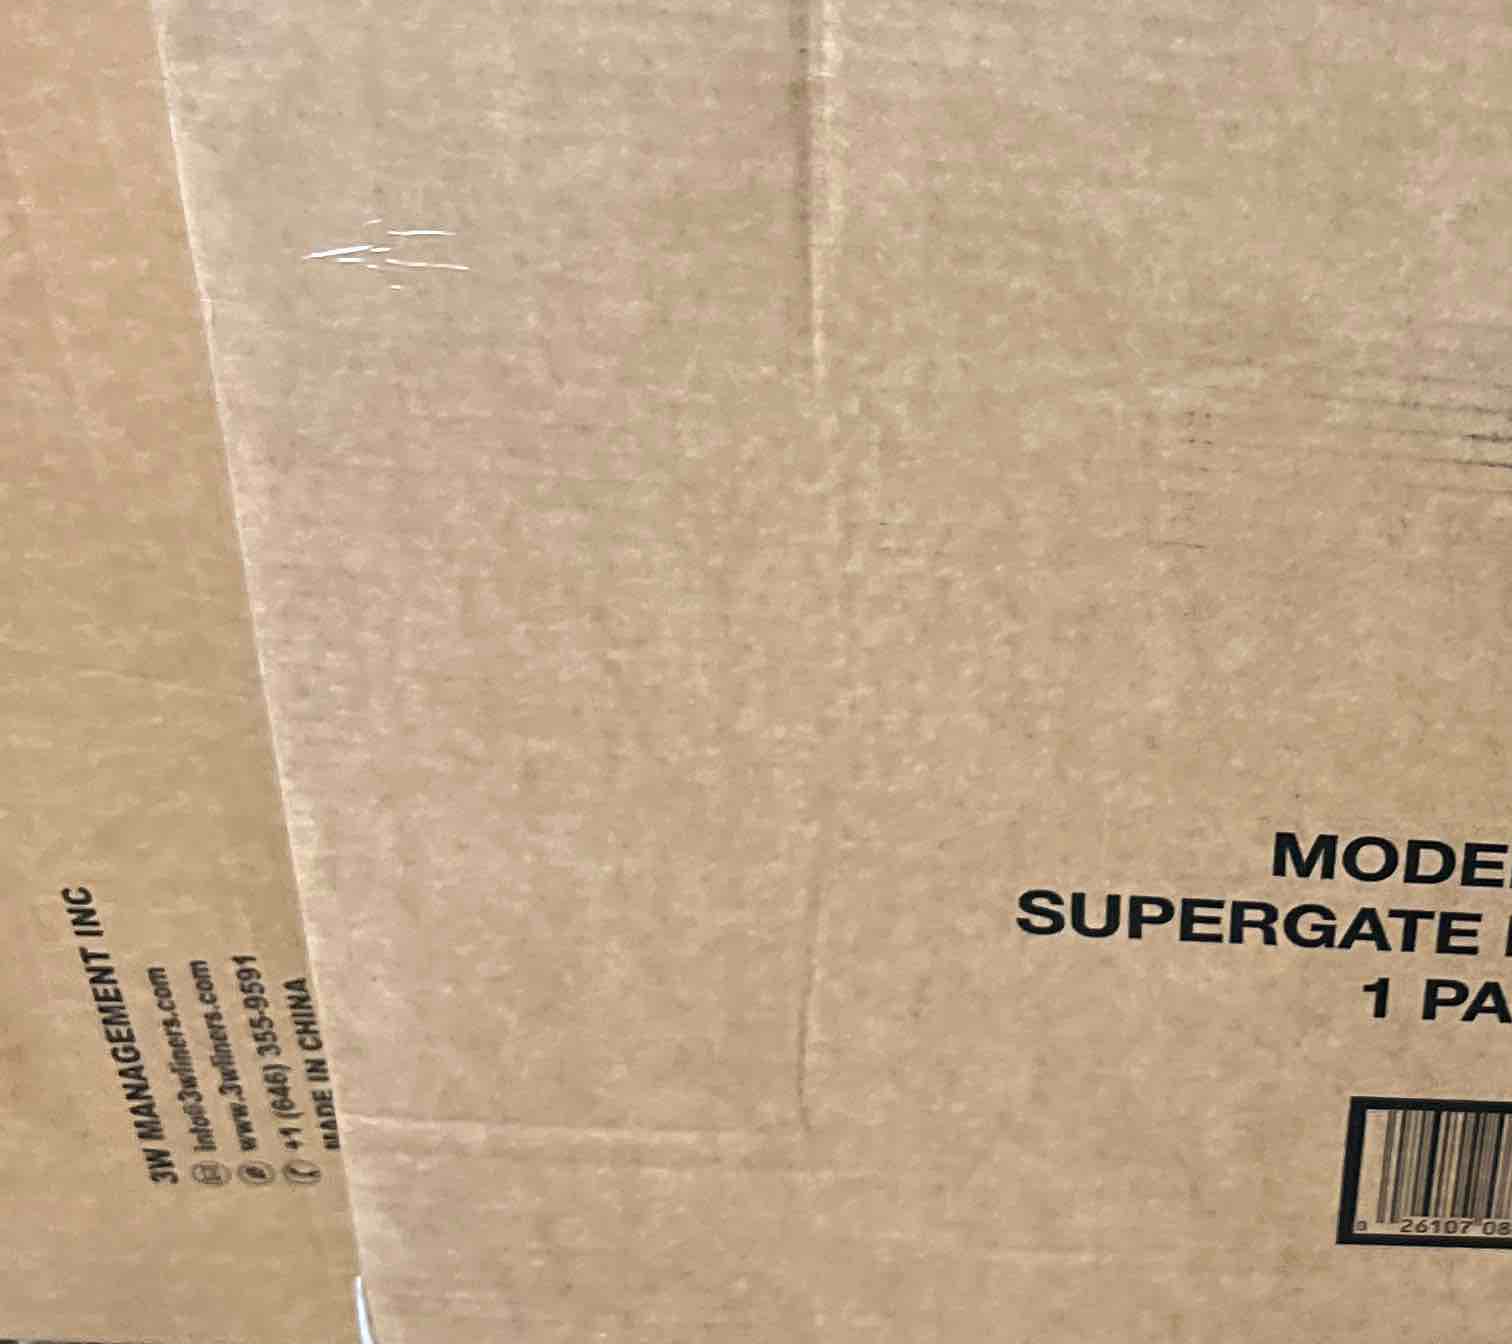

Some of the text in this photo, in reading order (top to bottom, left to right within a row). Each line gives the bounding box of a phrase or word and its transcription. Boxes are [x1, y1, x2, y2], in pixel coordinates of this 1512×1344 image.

[1016, 889, 1483, 956] SUPERGATE
[61, 886, 179, 1184] 3W MANAGEMENT INC
[231, 956, 304, 1150] +1 (646) 355-9591
[1362, 977, 1390, 1019] 1
[283, 977, 340, 1150] MADE IN CHINA
[1399, 1218, 1473, 1234] 26107
